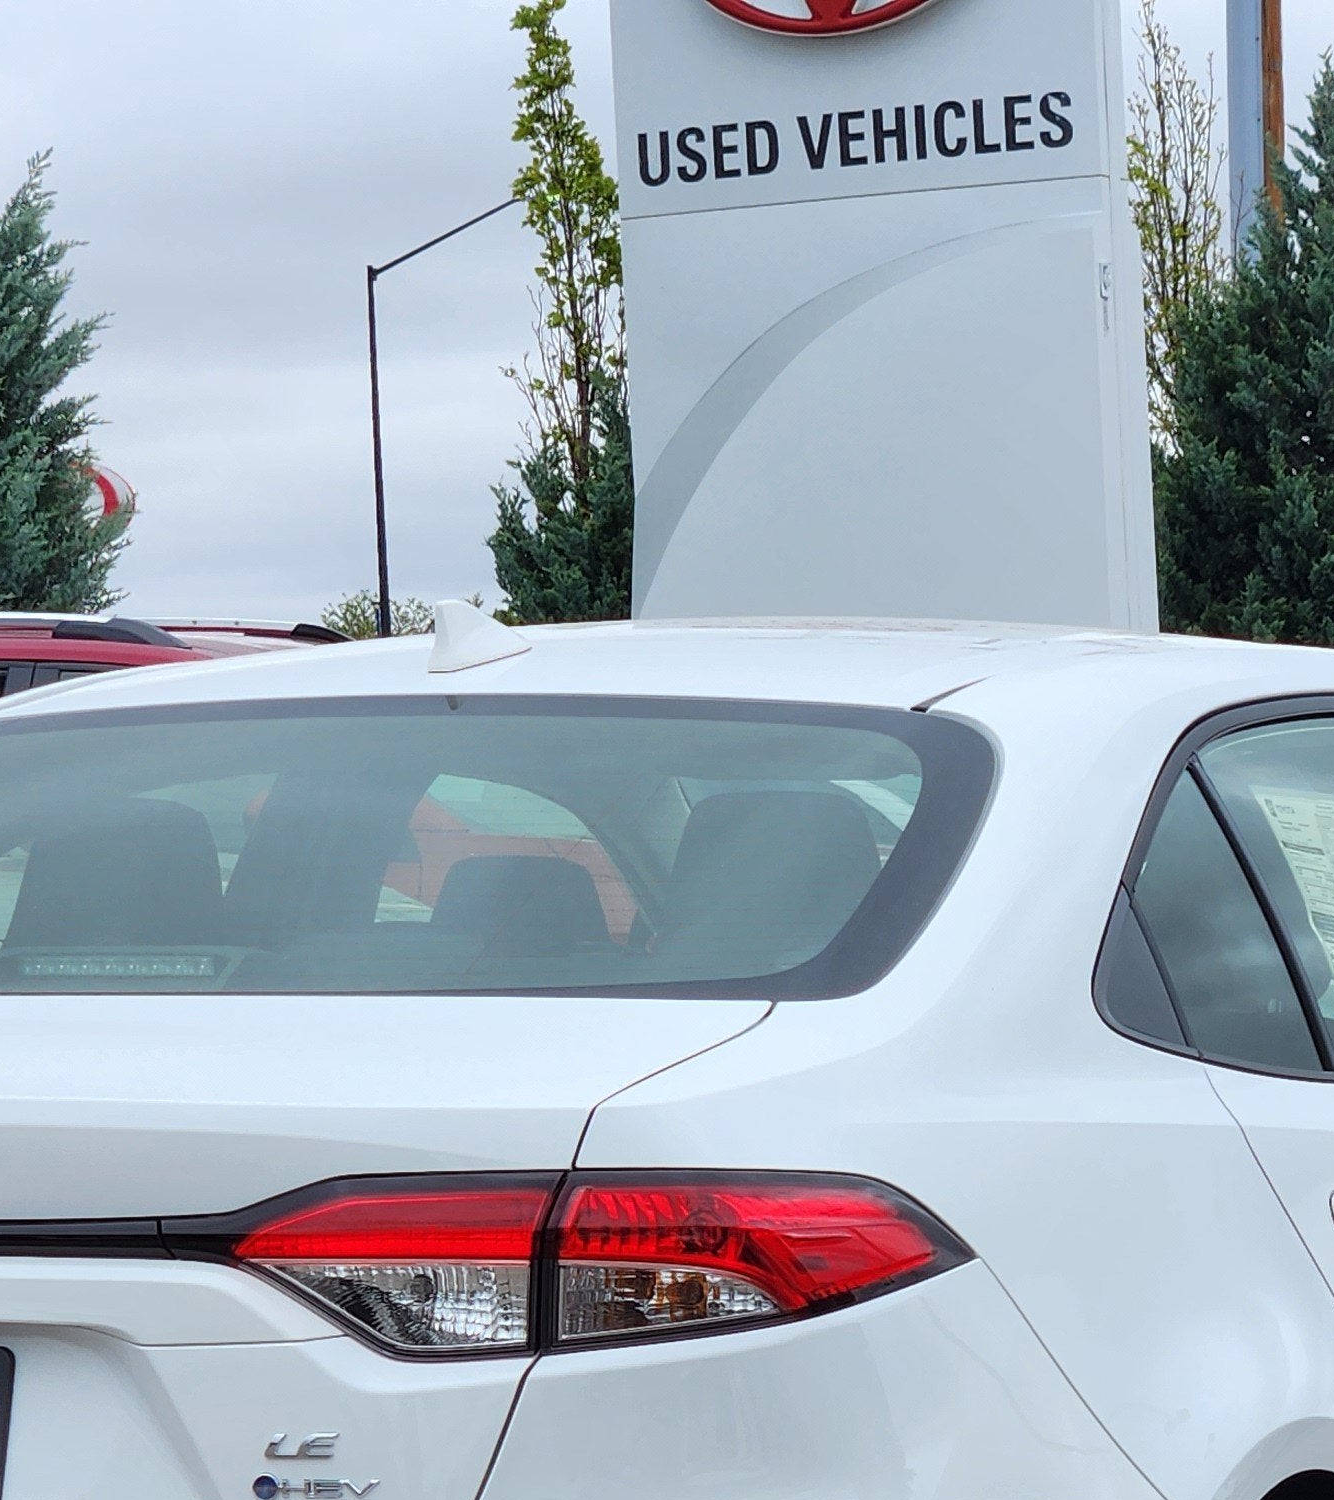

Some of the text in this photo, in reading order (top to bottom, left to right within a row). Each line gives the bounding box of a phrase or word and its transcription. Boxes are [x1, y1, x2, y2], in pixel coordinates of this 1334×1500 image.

[637, 91, 1074, 187] USED VEHICLES
[264, 1432, 340, 1459] LE
